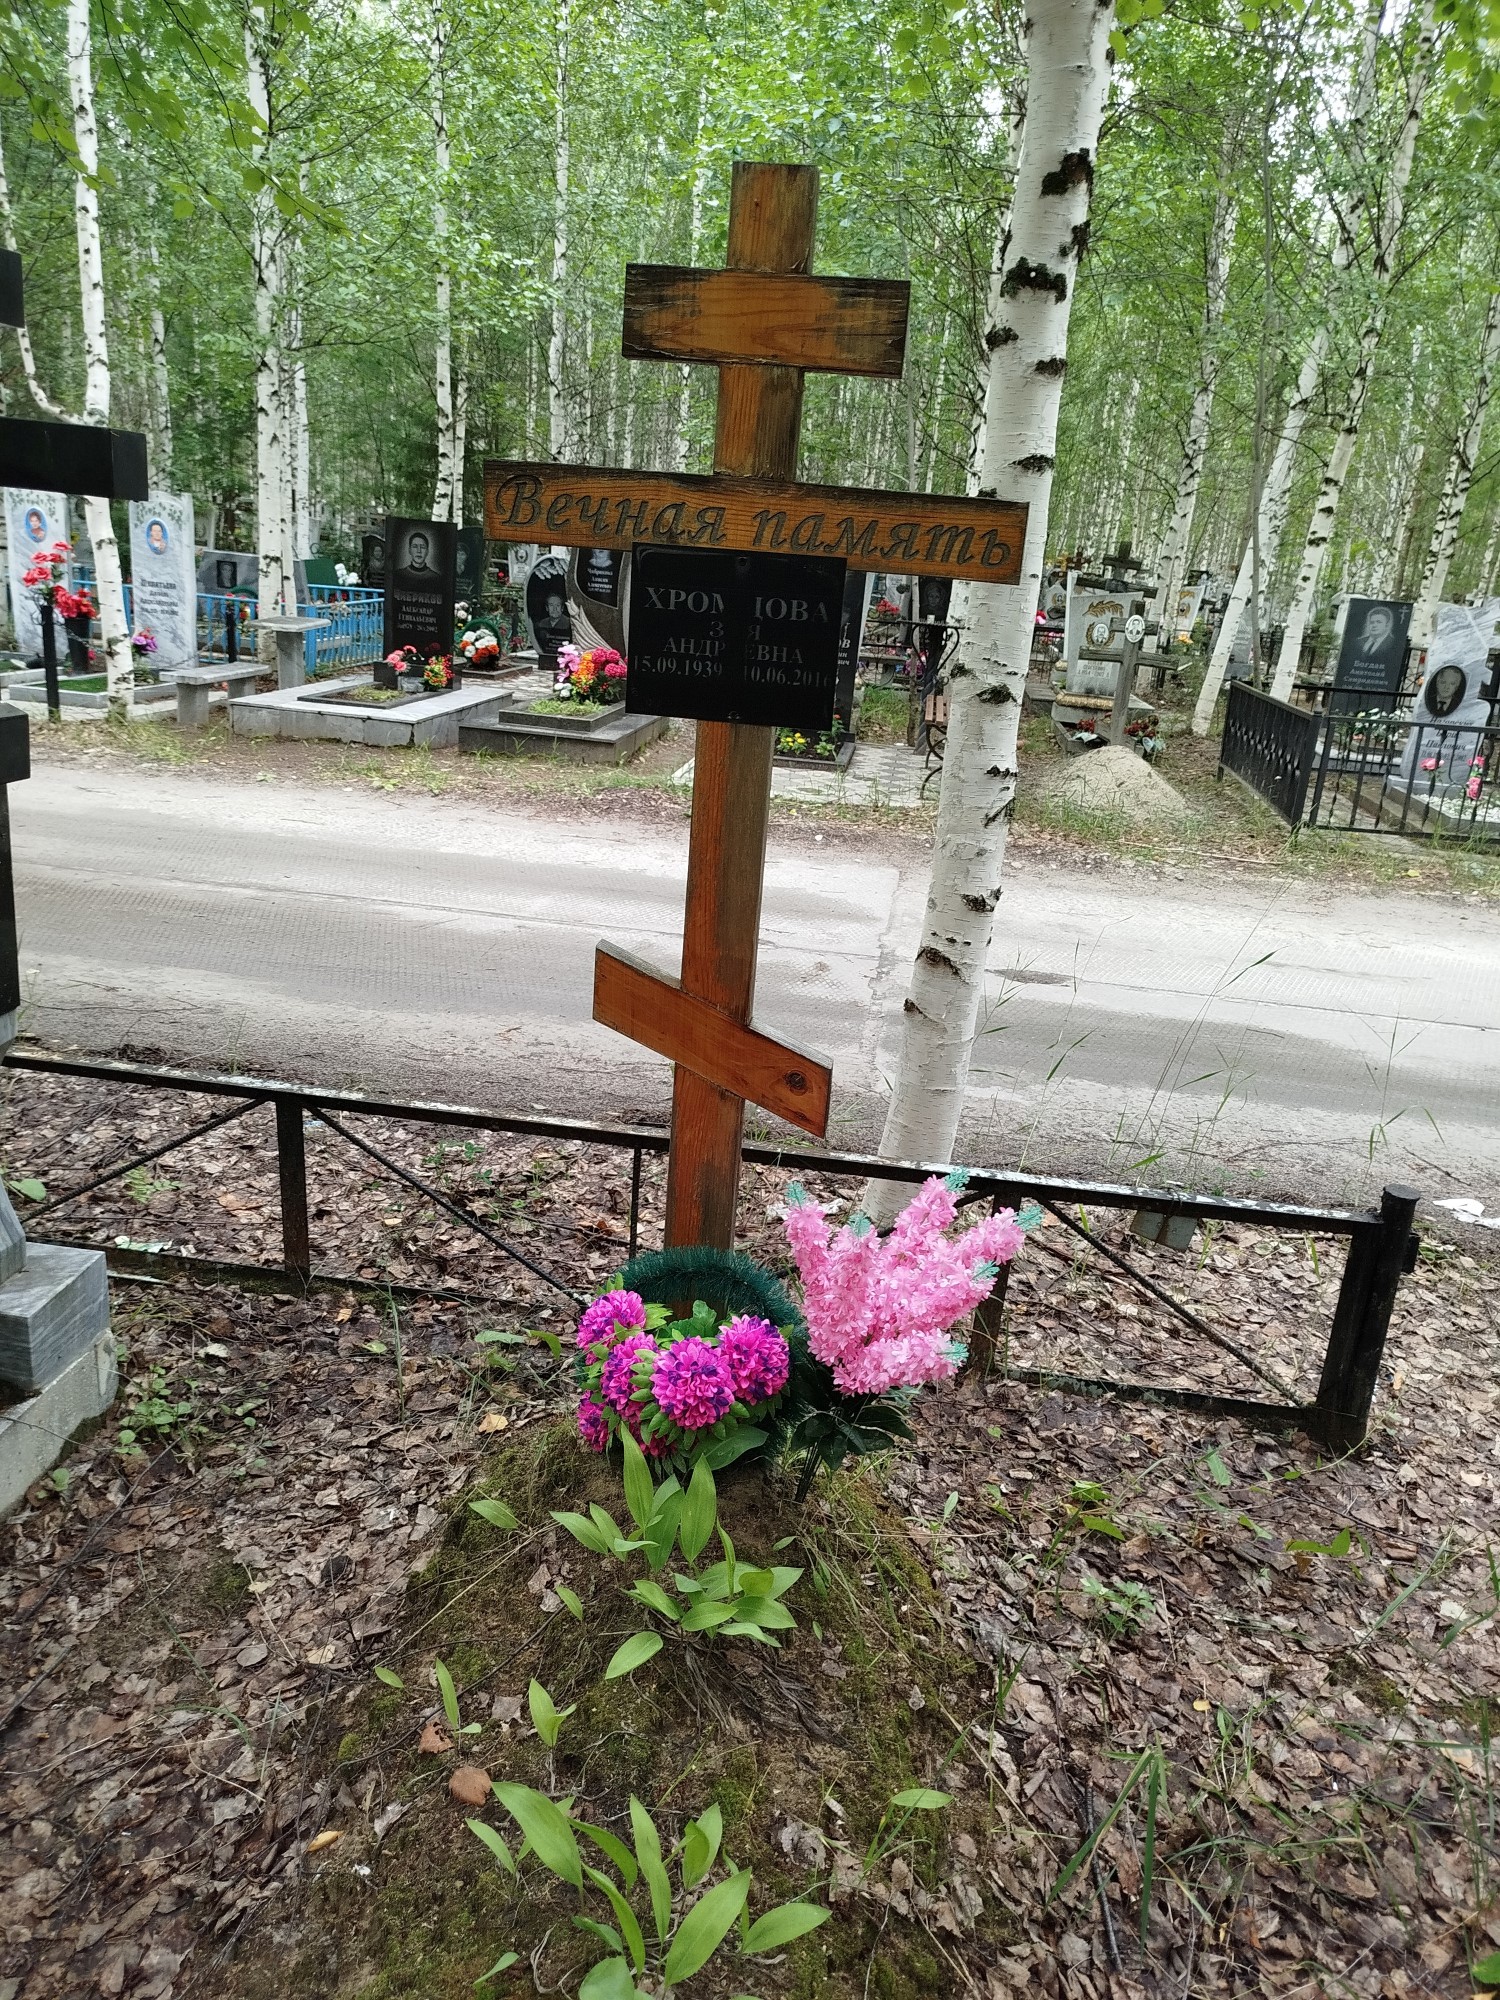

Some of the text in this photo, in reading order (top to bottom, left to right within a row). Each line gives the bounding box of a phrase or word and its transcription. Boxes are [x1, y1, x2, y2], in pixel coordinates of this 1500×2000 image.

[495, 474, 1011, 568] Вечная память
[709, 621, 760, 641] ЗЯ
[663, 637, 803, 664] АНДРЕВНА
[634, 655, 723, 678] 15.09.1939
